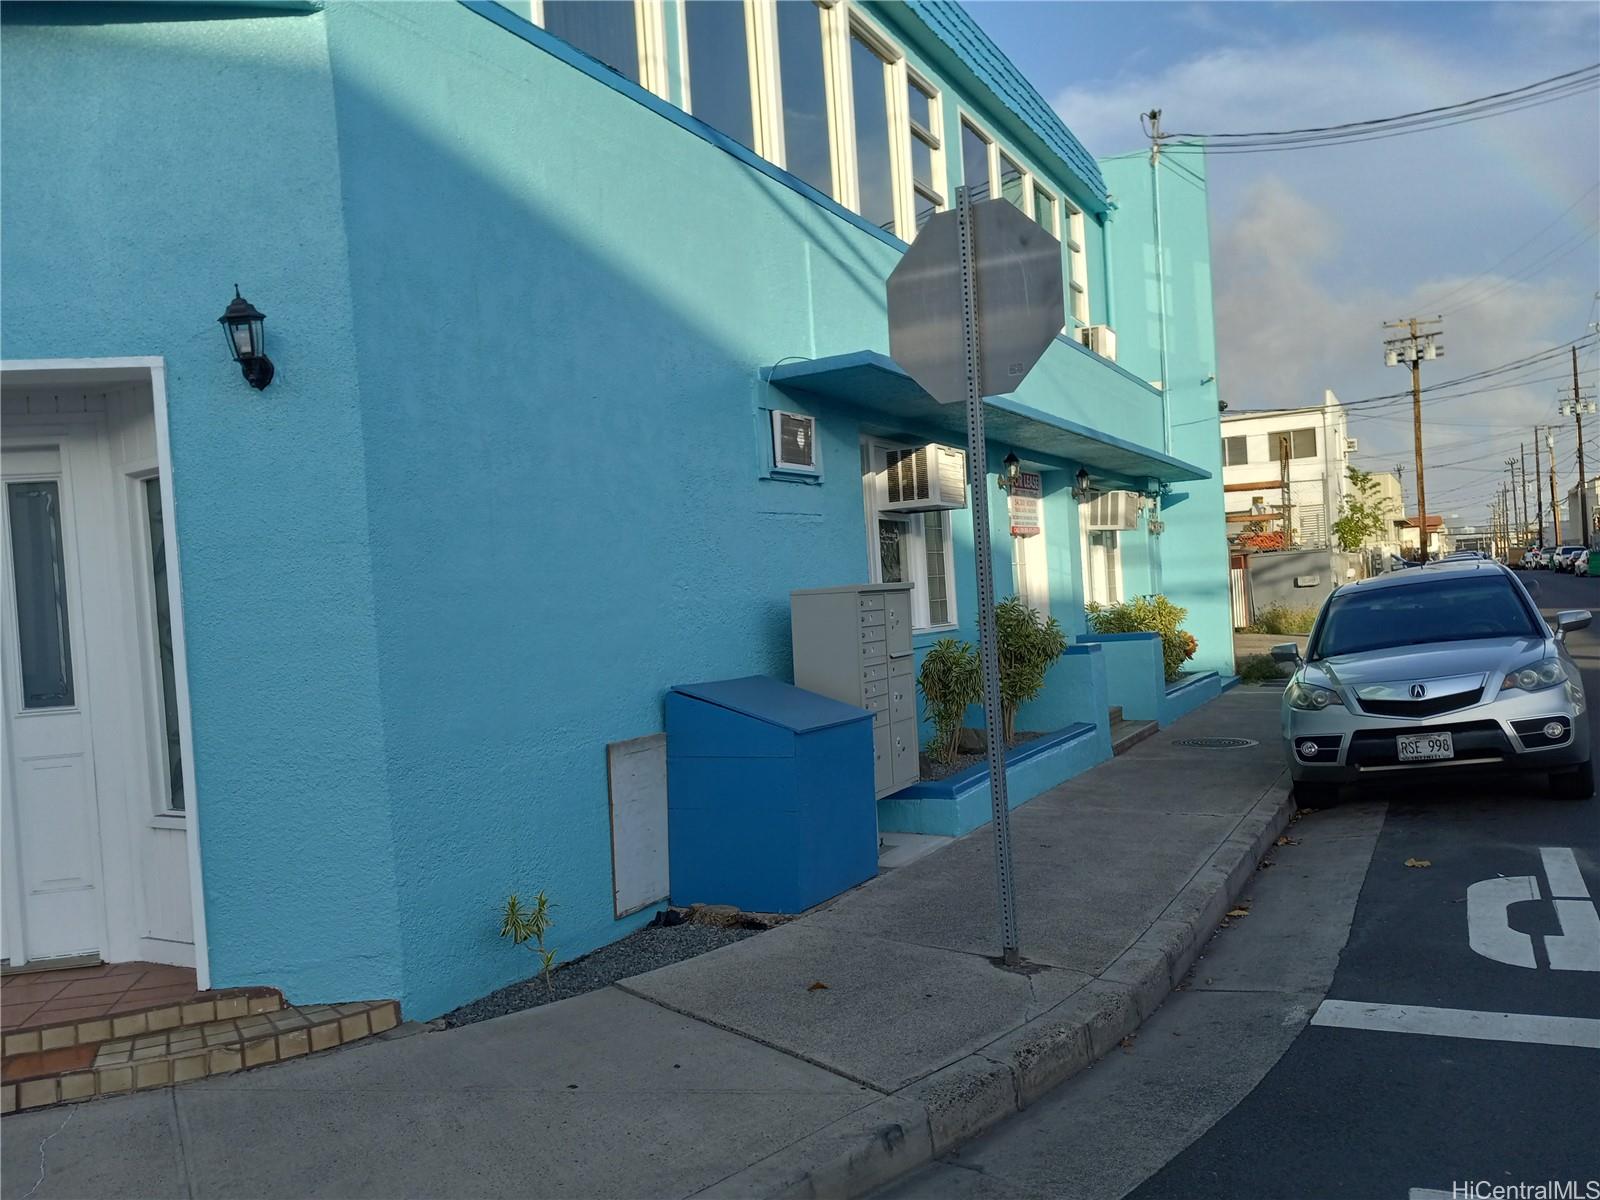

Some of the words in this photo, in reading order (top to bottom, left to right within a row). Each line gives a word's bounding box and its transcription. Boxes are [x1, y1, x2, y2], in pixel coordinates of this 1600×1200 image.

[1024, 473, 1040, 490] LEASE
[1400, 740, 1423, 755] RSE
[1427, 738, 1450, 753] 998
